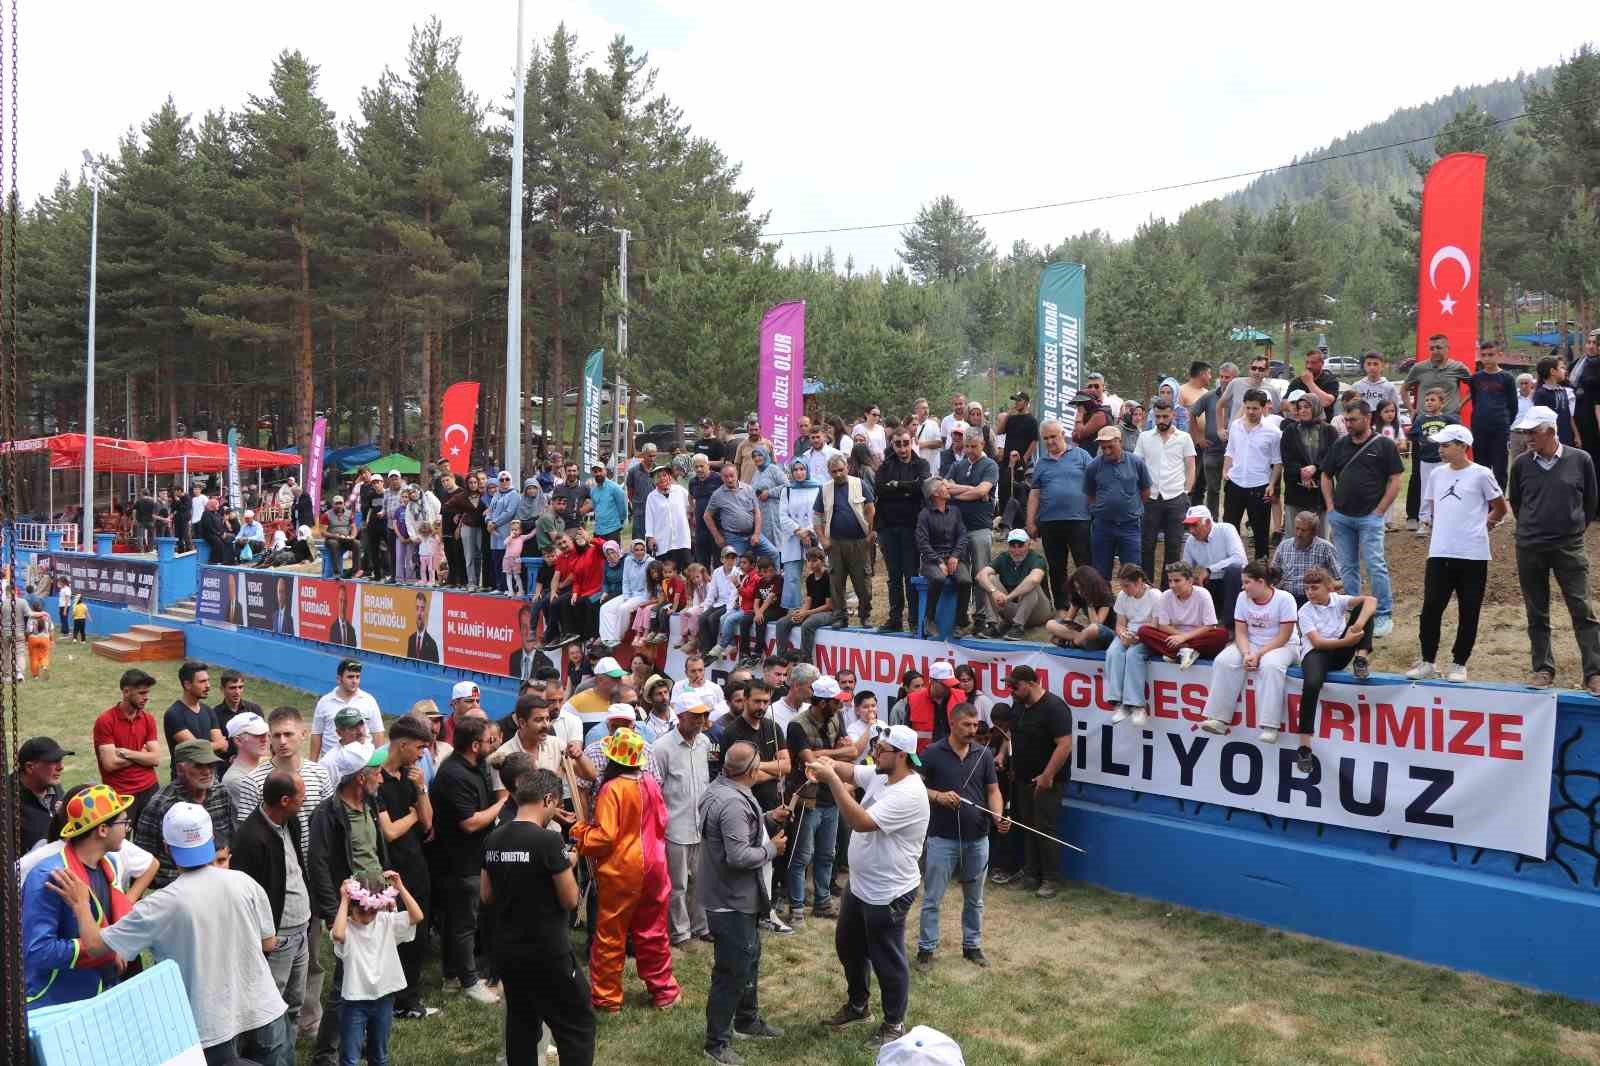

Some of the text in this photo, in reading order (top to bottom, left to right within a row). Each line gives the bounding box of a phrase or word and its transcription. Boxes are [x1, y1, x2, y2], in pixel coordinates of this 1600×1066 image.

[773, 333, 792, 371] OLUR
[364, 592, 393, 609] İBRAHİM
[457, 621, 485, 639] HANİFİ
[486, 624, 514, 642] MACİT
[1077, 720, 1454, 828] İLİYORUZ
